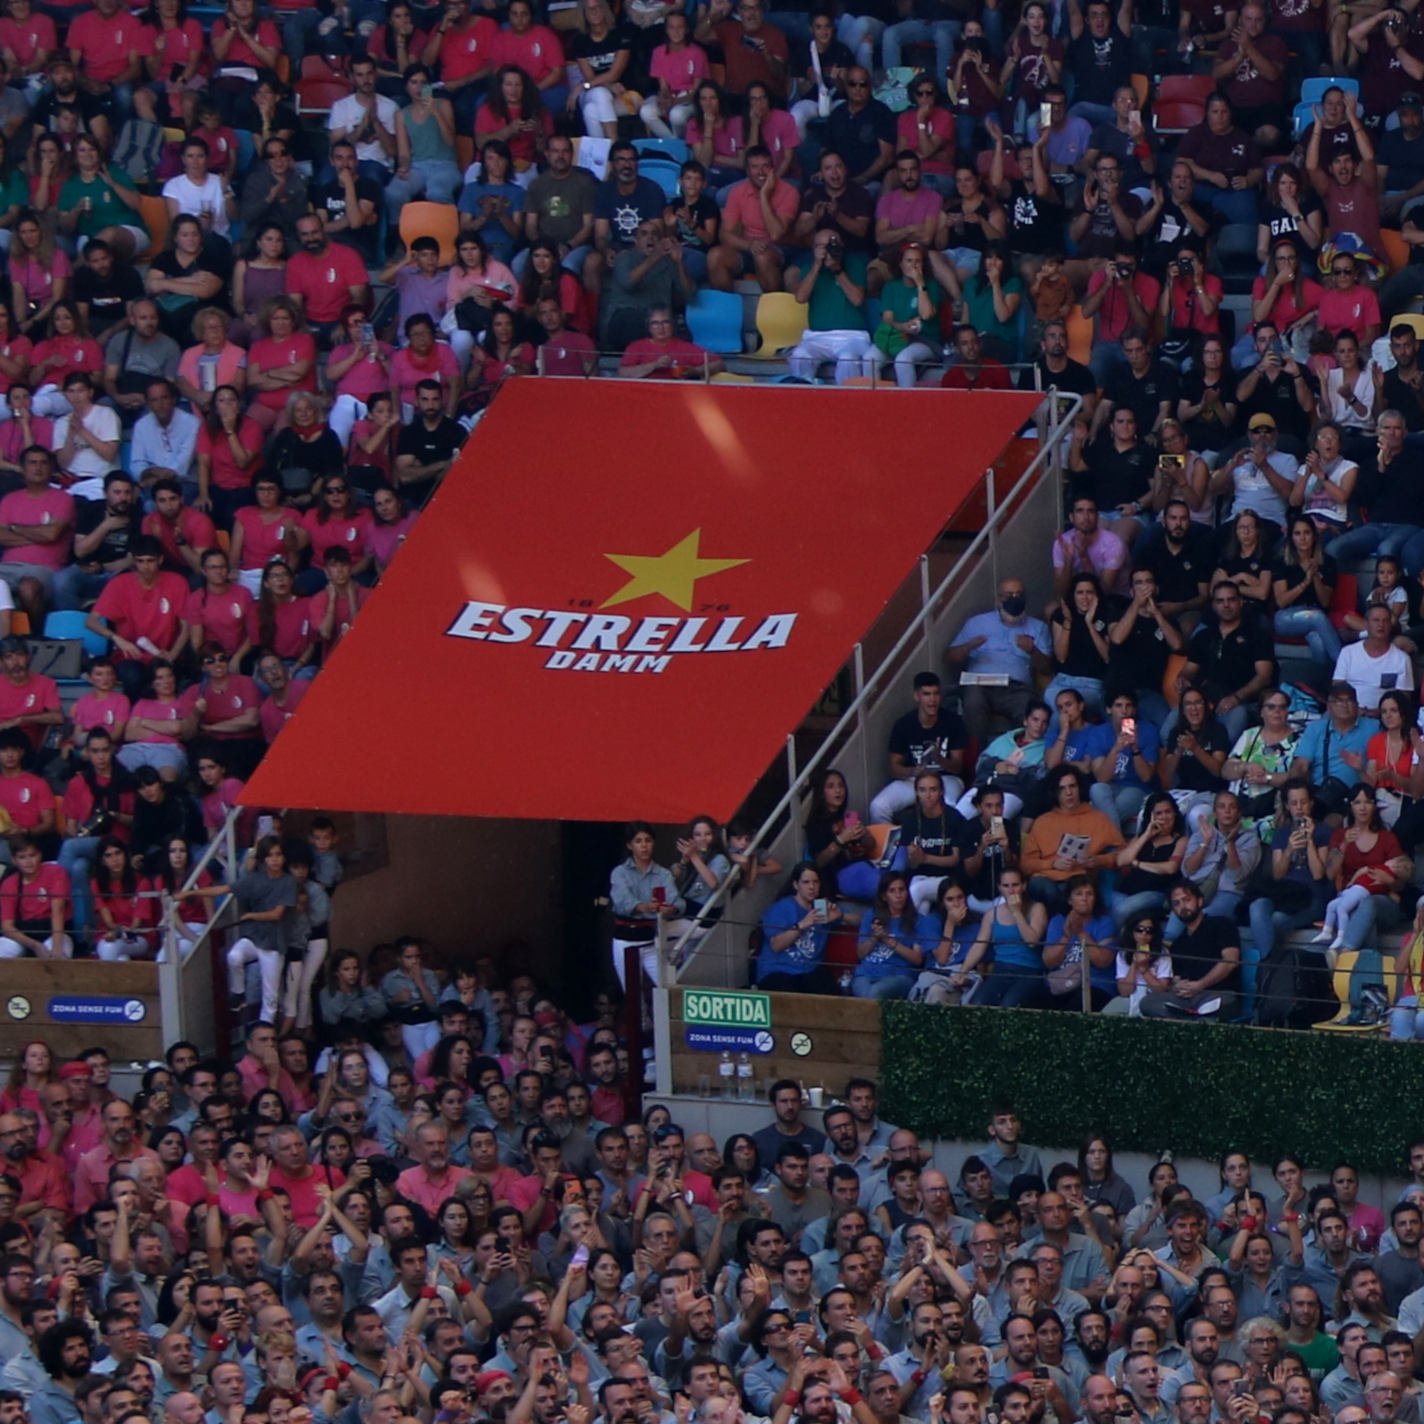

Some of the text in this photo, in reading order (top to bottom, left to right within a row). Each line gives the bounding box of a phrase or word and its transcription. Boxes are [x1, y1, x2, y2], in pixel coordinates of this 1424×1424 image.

[445, 599, 799, 654] ESTRELLA
[544, 650, 674, 673] DAMM
[52, 1004, 123, 1014] ZONA SENSE FUM
[687, 994, 766, 1022] SORTIDA
[689, 1033, 754, 1044] ZONA SENSE FUM
